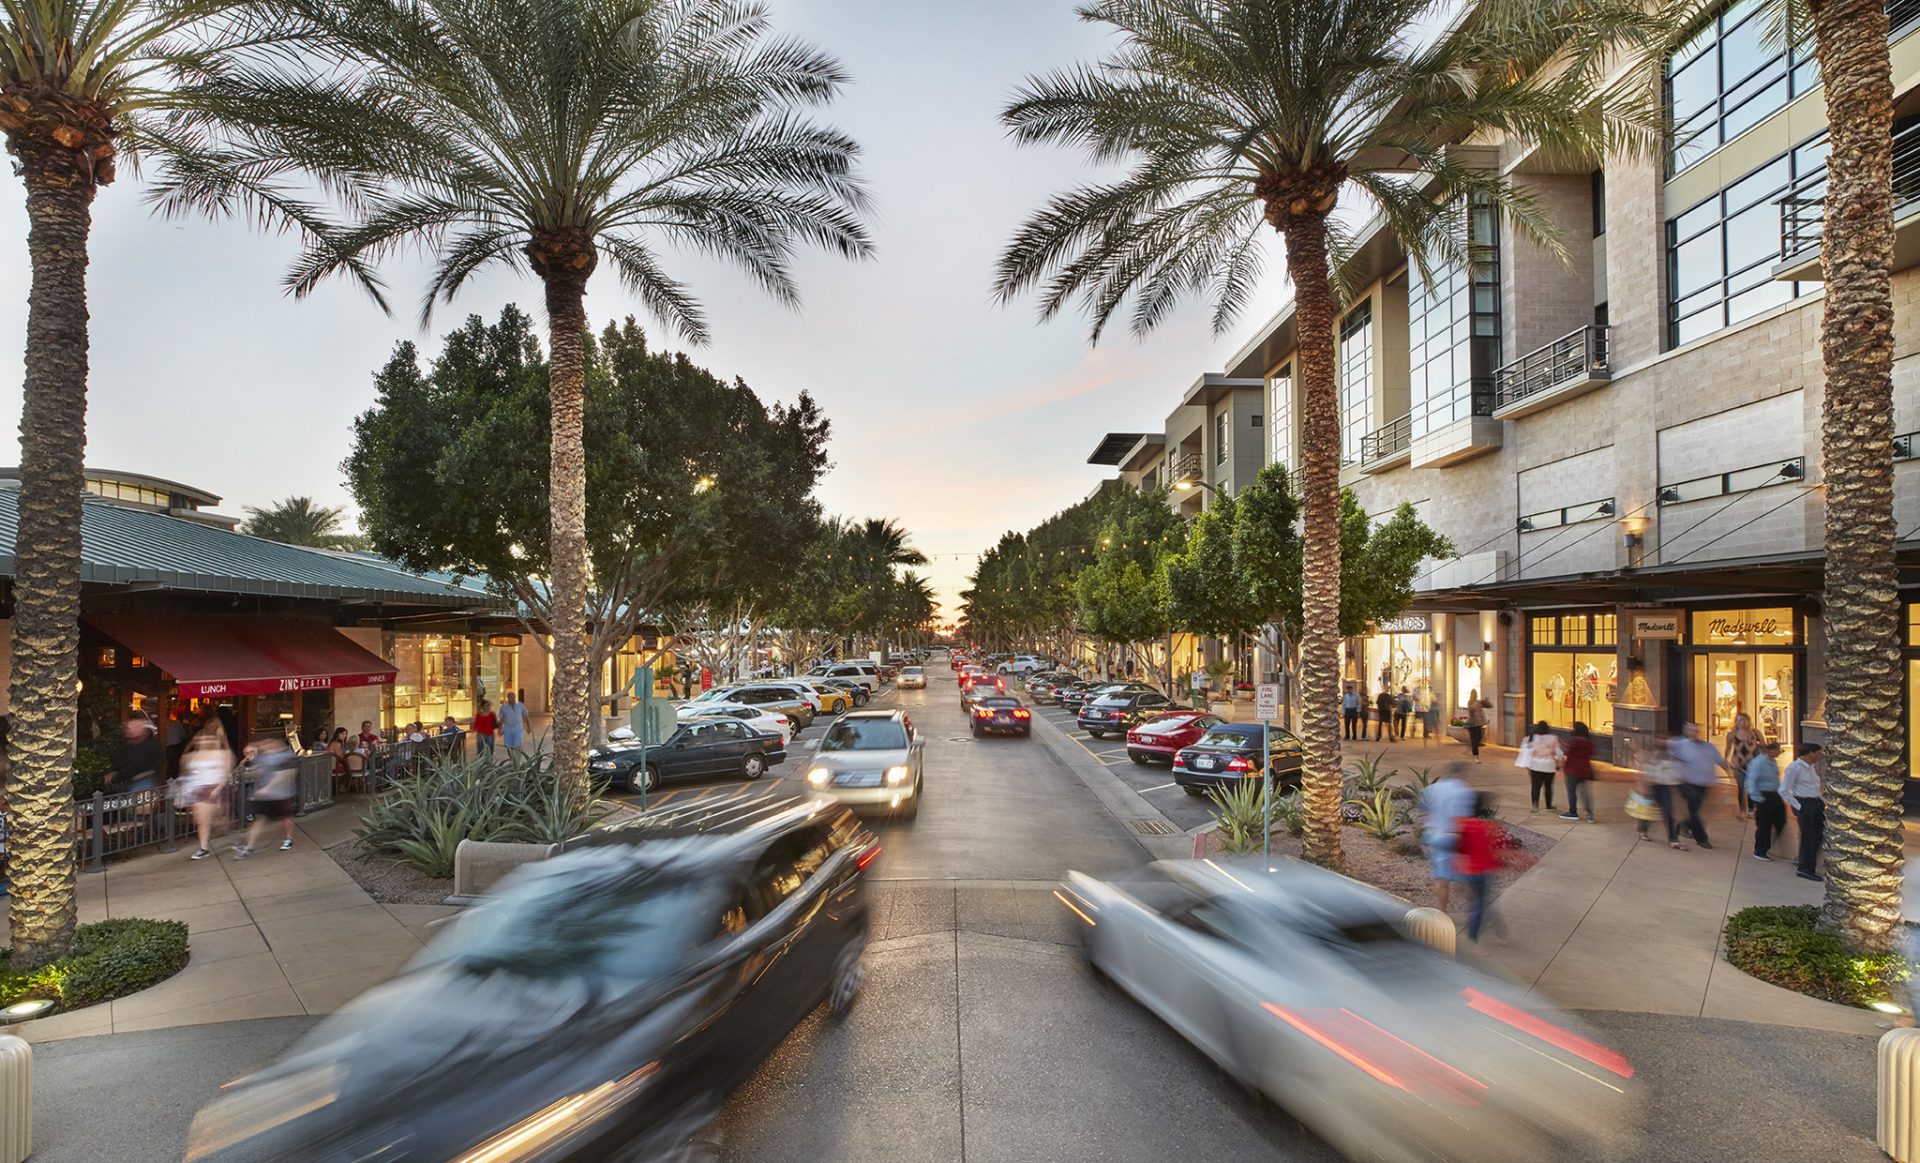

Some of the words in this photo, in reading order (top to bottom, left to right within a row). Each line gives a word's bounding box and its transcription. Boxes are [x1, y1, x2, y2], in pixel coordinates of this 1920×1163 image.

[1638, 622, 1675, 632] Madewell
[1709, 618, 1776, 637] Madewell
[201, 685, 226, 694] LUNCH
[280, 678, 299, 690] ZINC
